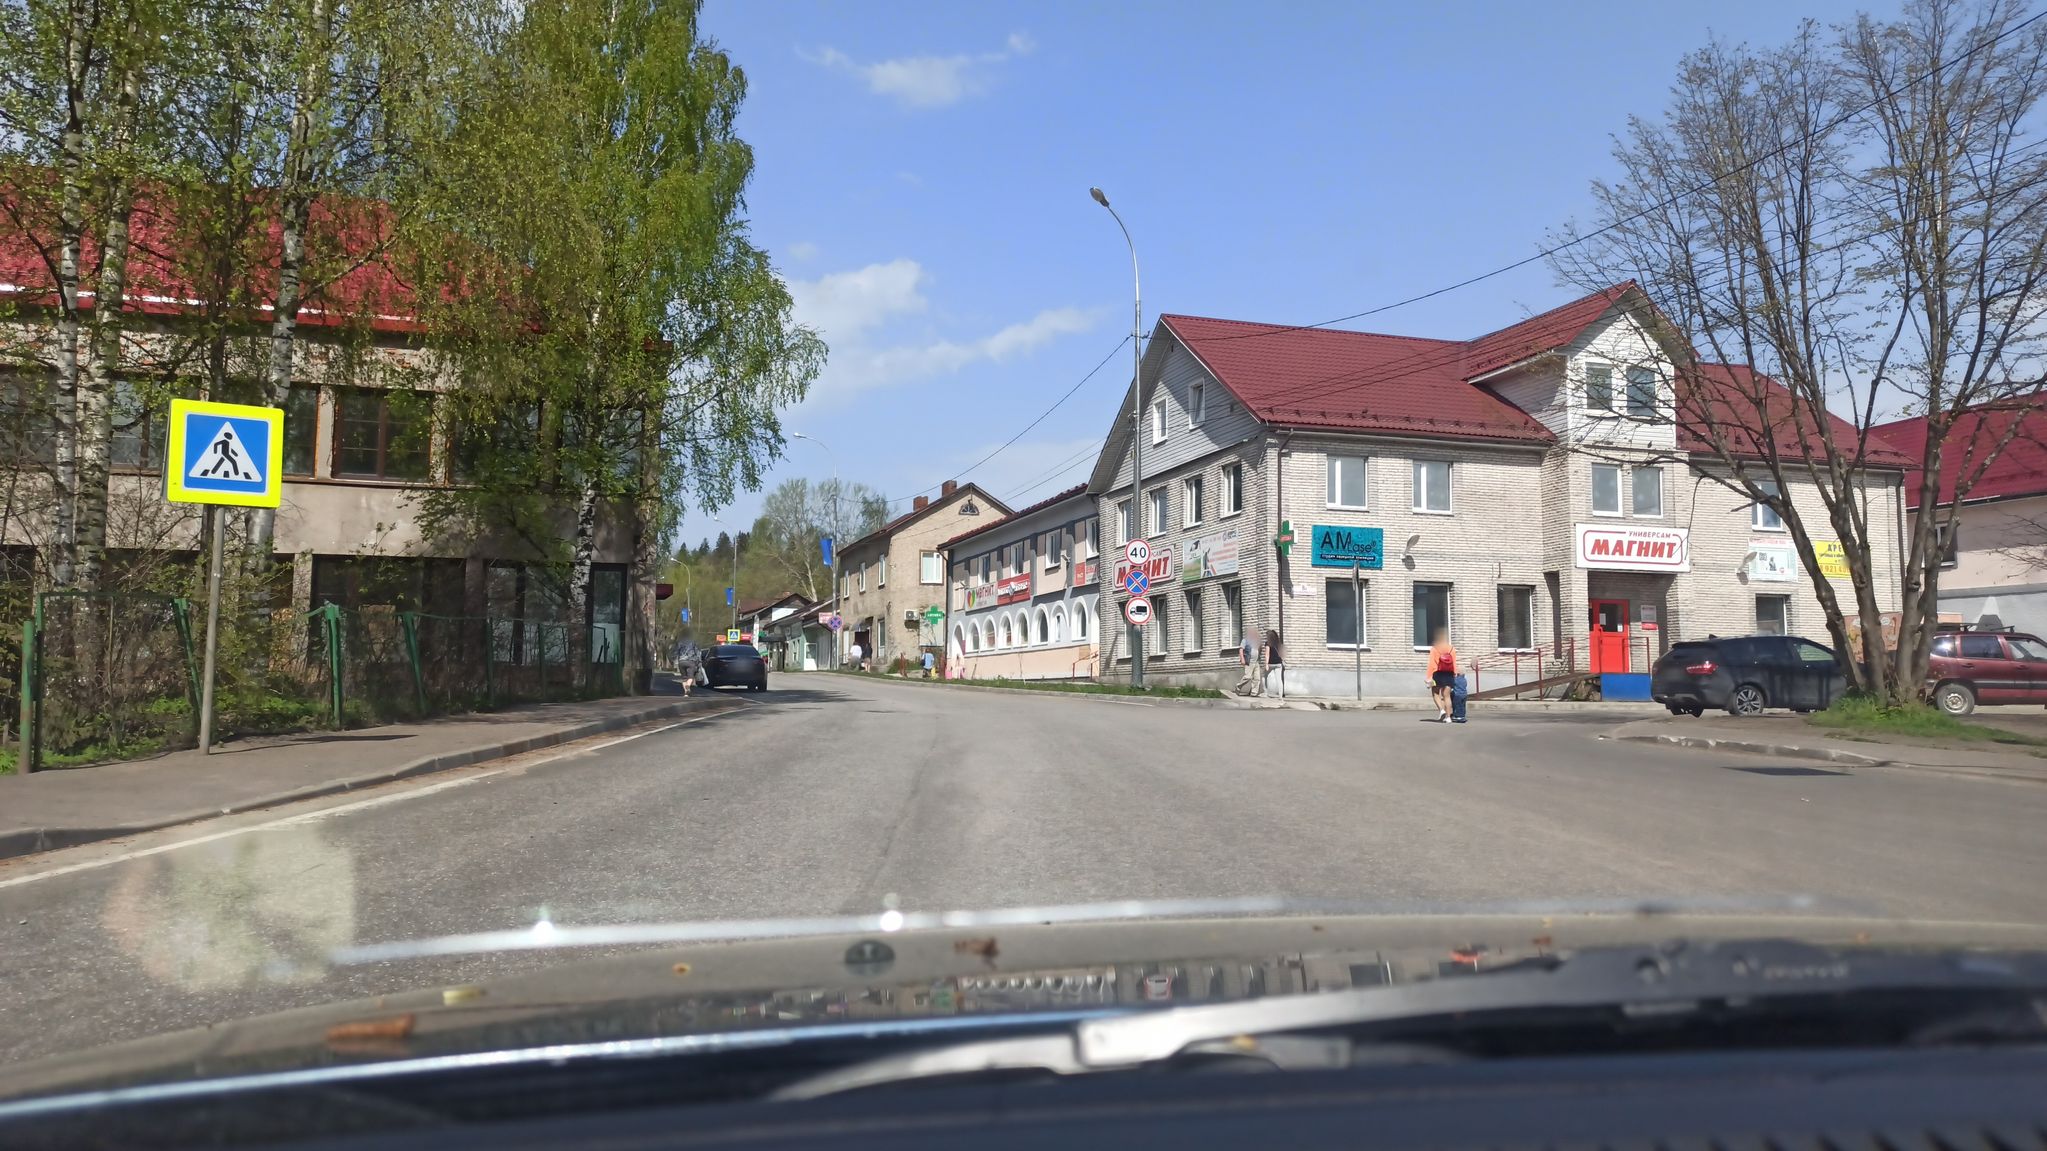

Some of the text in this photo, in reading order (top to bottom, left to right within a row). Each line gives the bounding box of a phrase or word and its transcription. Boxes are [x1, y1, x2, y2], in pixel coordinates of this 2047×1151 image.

[1628, 530, 1671, 539] УНИВЕРСАМ
[1130, 547, 1147, 558] 40
[1590, 539, 1677, 559] МАГНИТ
[1827, 544, 1842, 553] АРЕ
[1116, 556, 1170, 585] МНИТ
